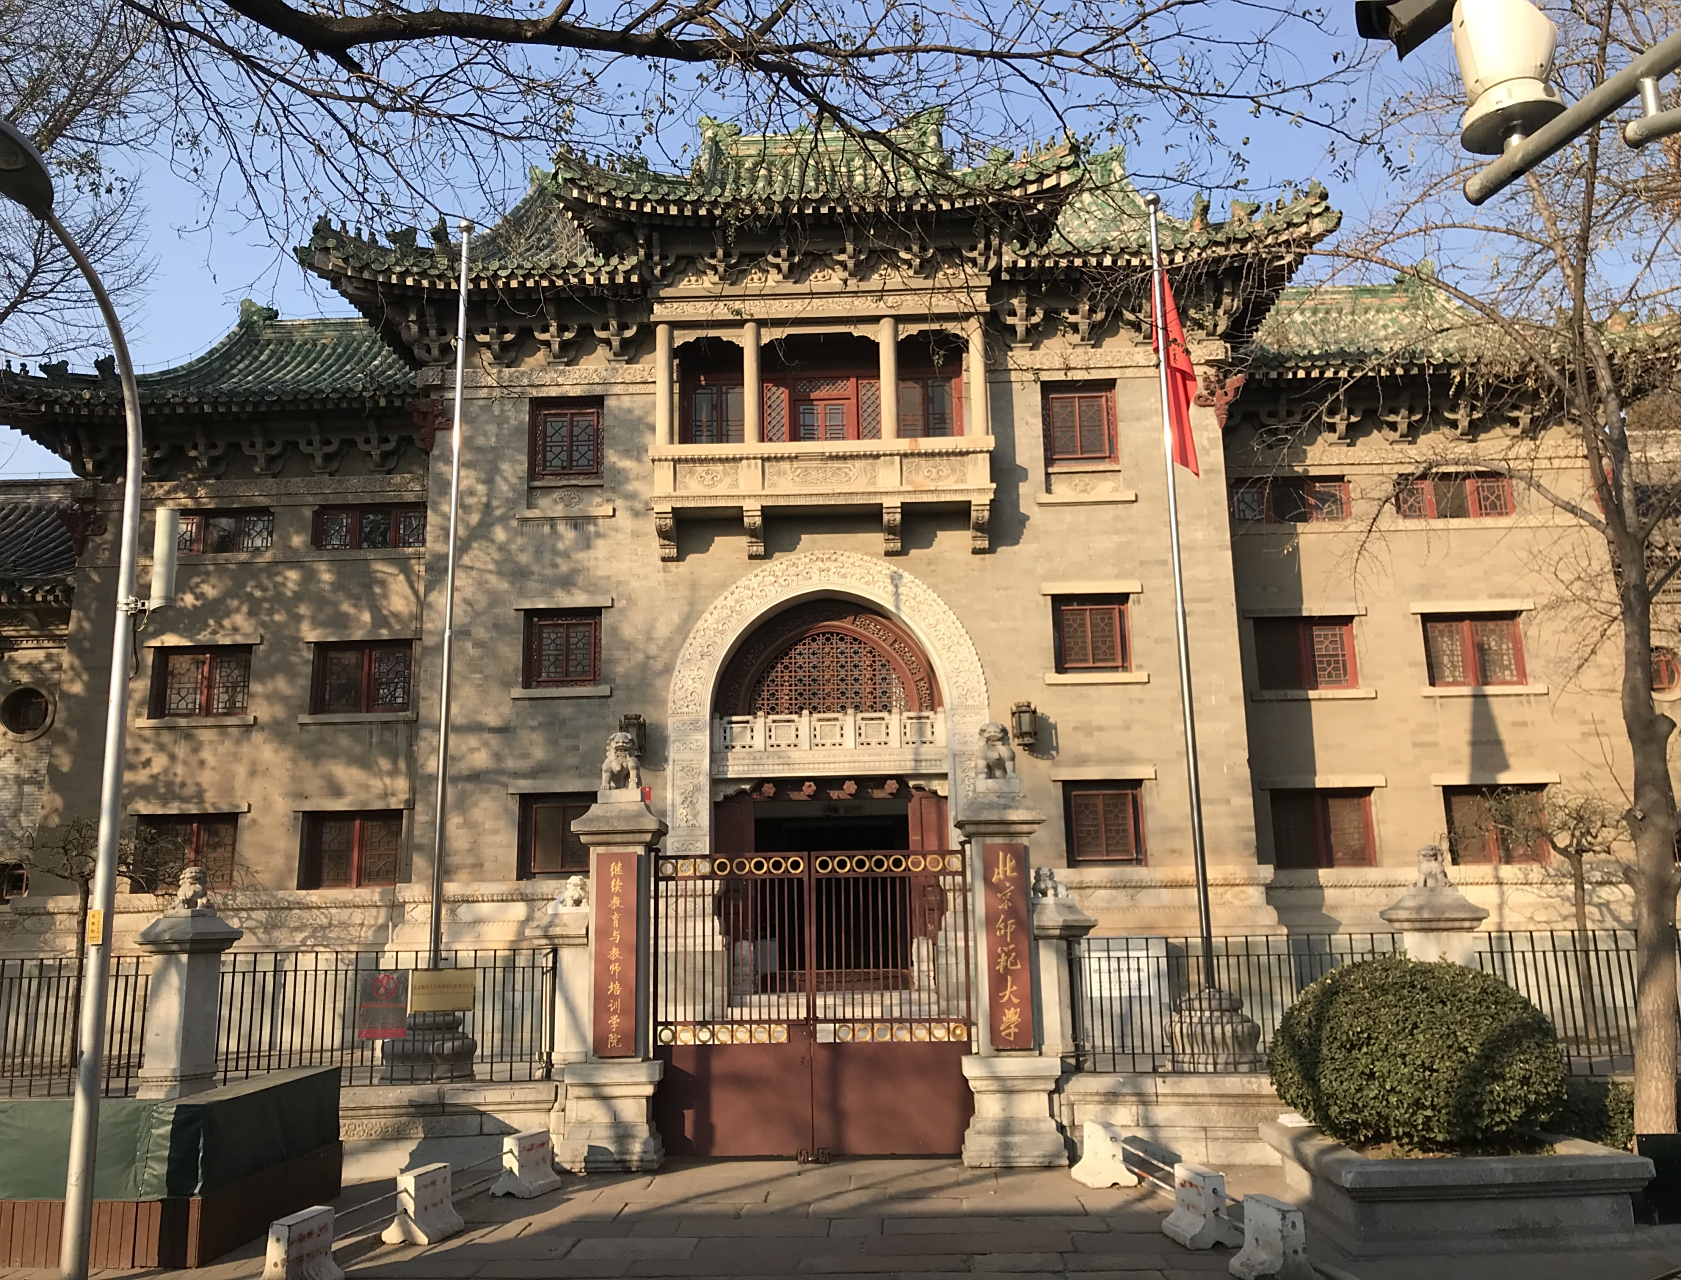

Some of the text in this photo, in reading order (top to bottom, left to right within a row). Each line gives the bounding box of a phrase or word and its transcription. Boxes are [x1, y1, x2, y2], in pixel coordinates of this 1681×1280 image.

[607, 861, 624, 1048] 继续教育与教师培训学院
